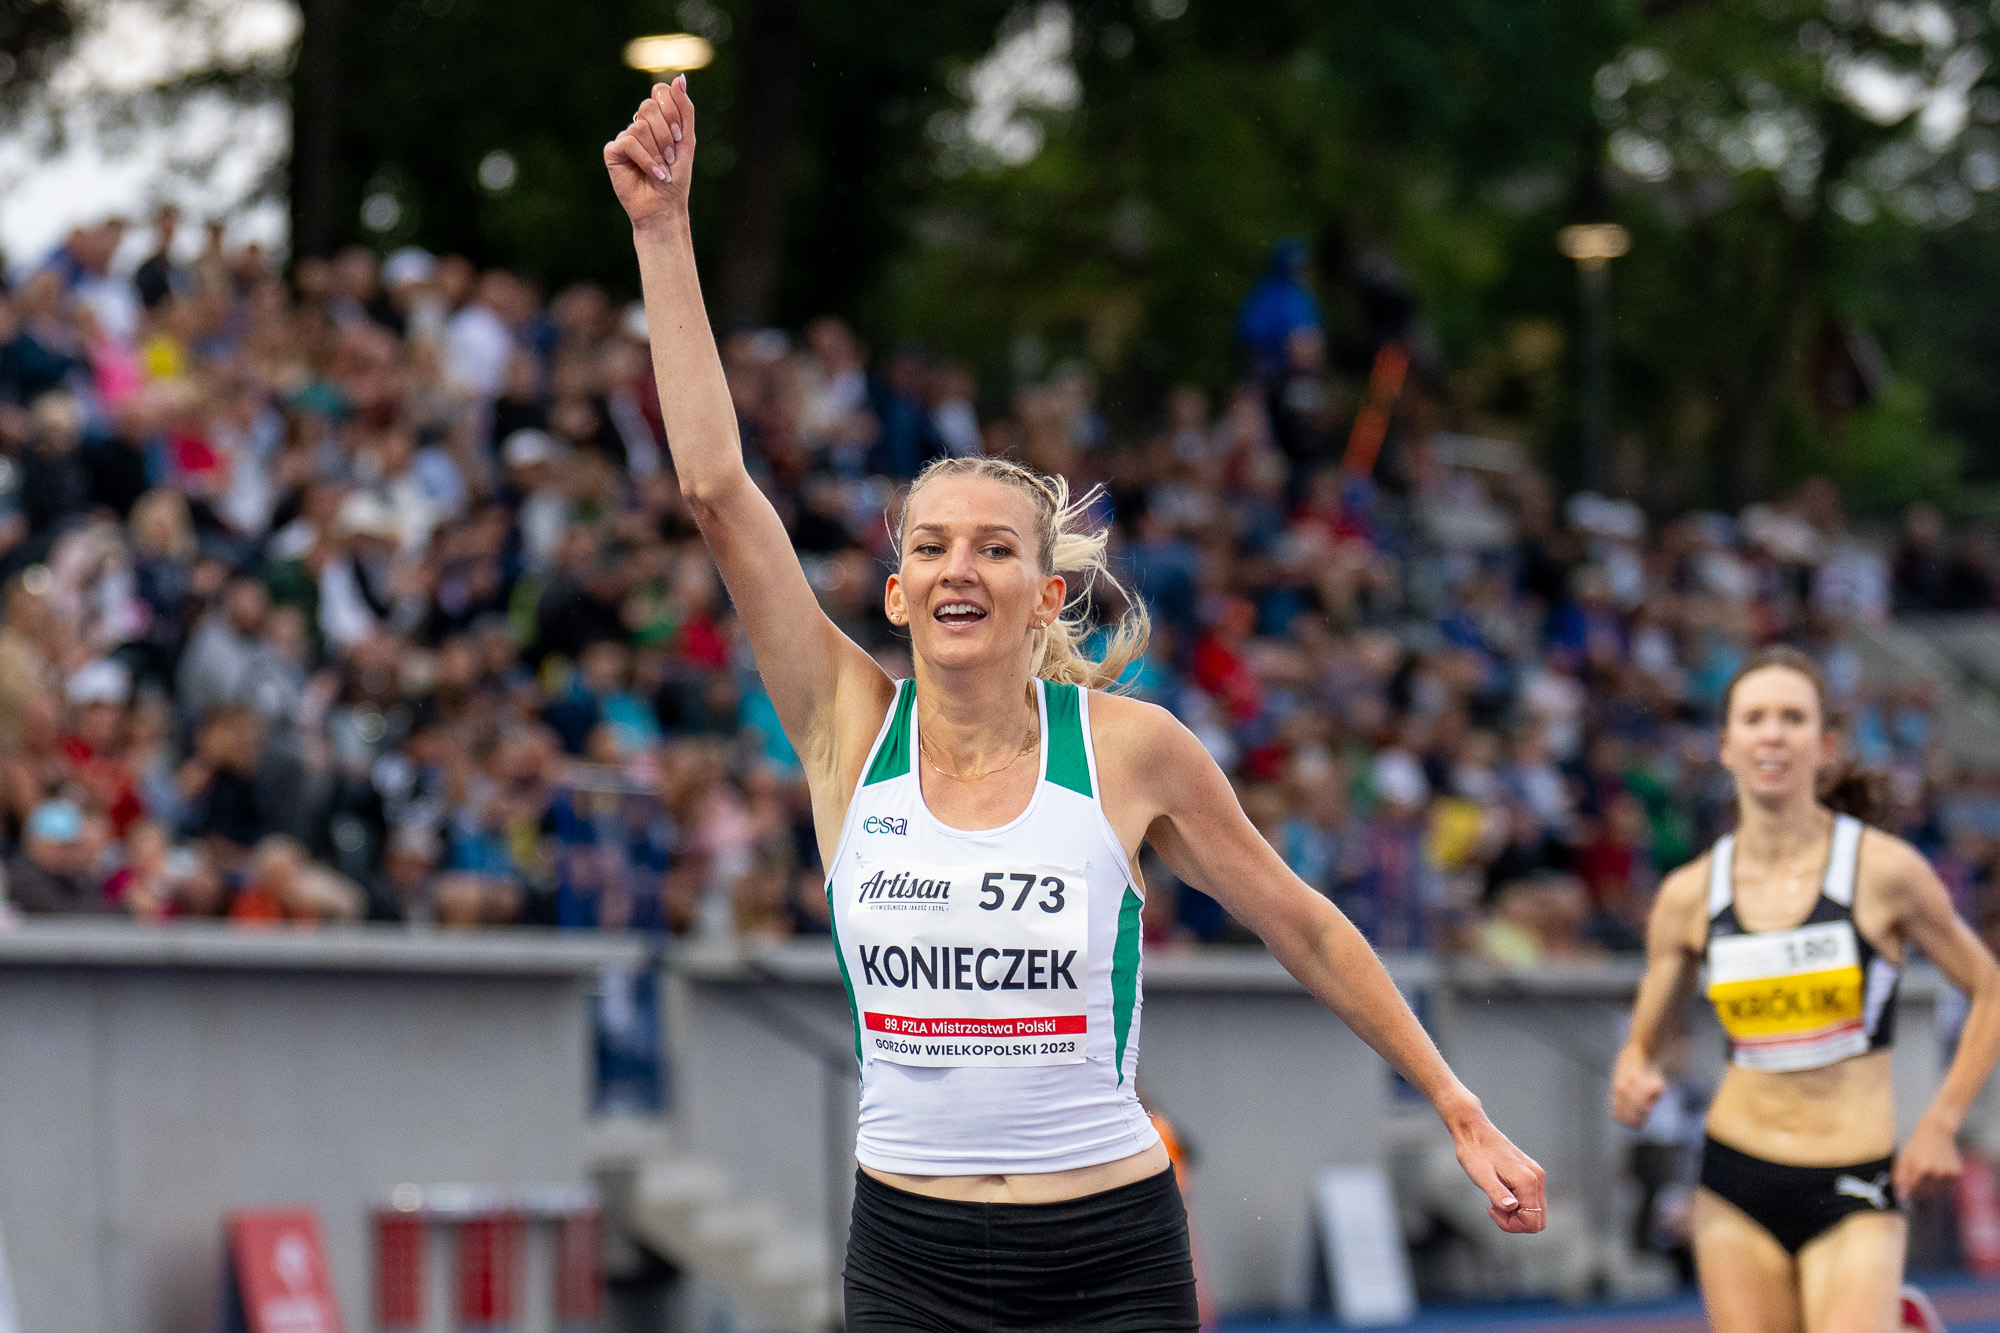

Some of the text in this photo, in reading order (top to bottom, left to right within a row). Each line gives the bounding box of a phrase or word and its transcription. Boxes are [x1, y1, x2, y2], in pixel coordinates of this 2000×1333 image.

[858, 870, 951, 903] Artisan
[978, 872, 1066, 914] 573
[859, 945, 1078, 991] KONIECZEK
[1728, 985, 1844, 1021] KRÓLIK
[884, 1018, 1056, 1034] 99. PZLA Mistrzostwa Polski
[875, 1038, 1075, 1056] GORZÓW WIELKOPOLSKI 2023
